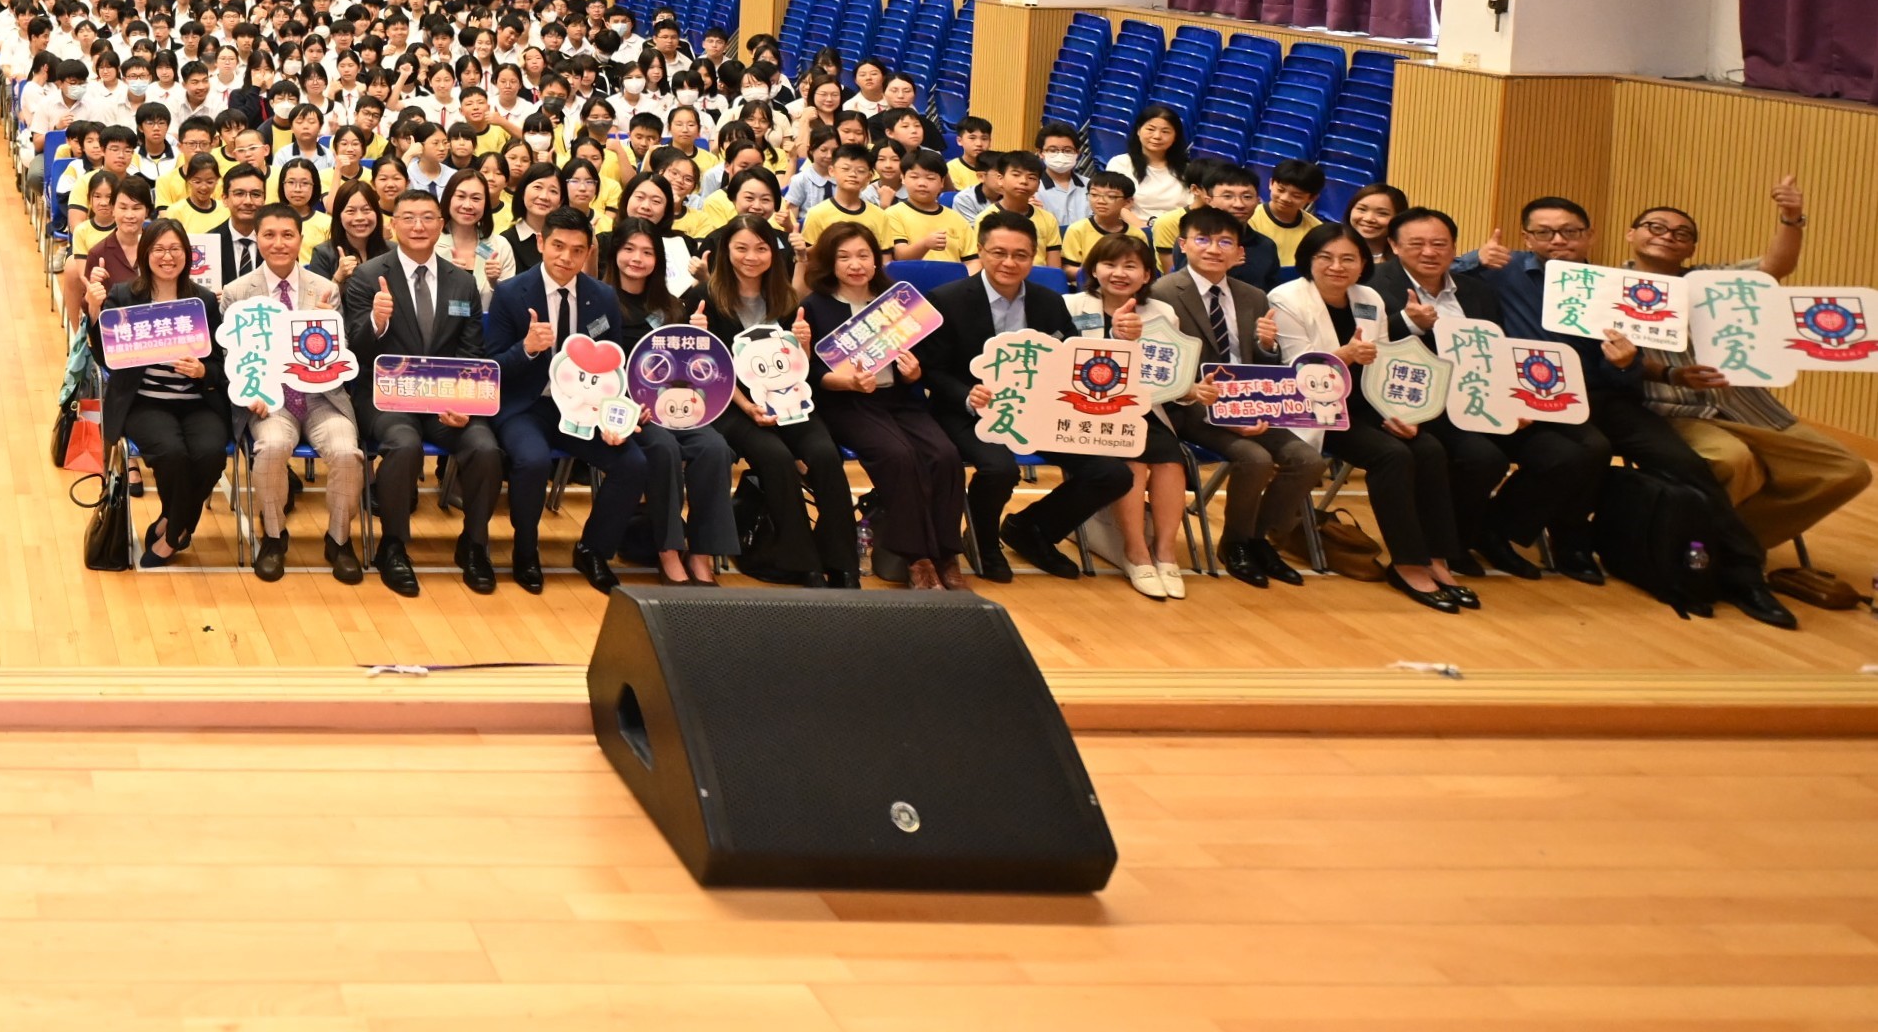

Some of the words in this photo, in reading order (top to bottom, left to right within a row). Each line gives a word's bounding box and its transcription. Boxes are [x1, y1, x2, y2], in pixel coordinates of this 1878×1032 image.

[113, 315, 194, 343] 博愛禁毒
[834, 297, 906, 356] 博愛與你
[651, 335, 710, 350] 無毒校園
[1392, 364, 1427, 385] 博愛
[377, 376, 496, 400] 守護社區健康
[1387, 383, 1423, 404] 禁毒
[1057, 418, 1136, 437] 博愛醫院
[1056, 434, 1075, 443] Pok
[1078, 436, 1090, 444] Oi
[1093, 437, 1135, 448] Hospital
